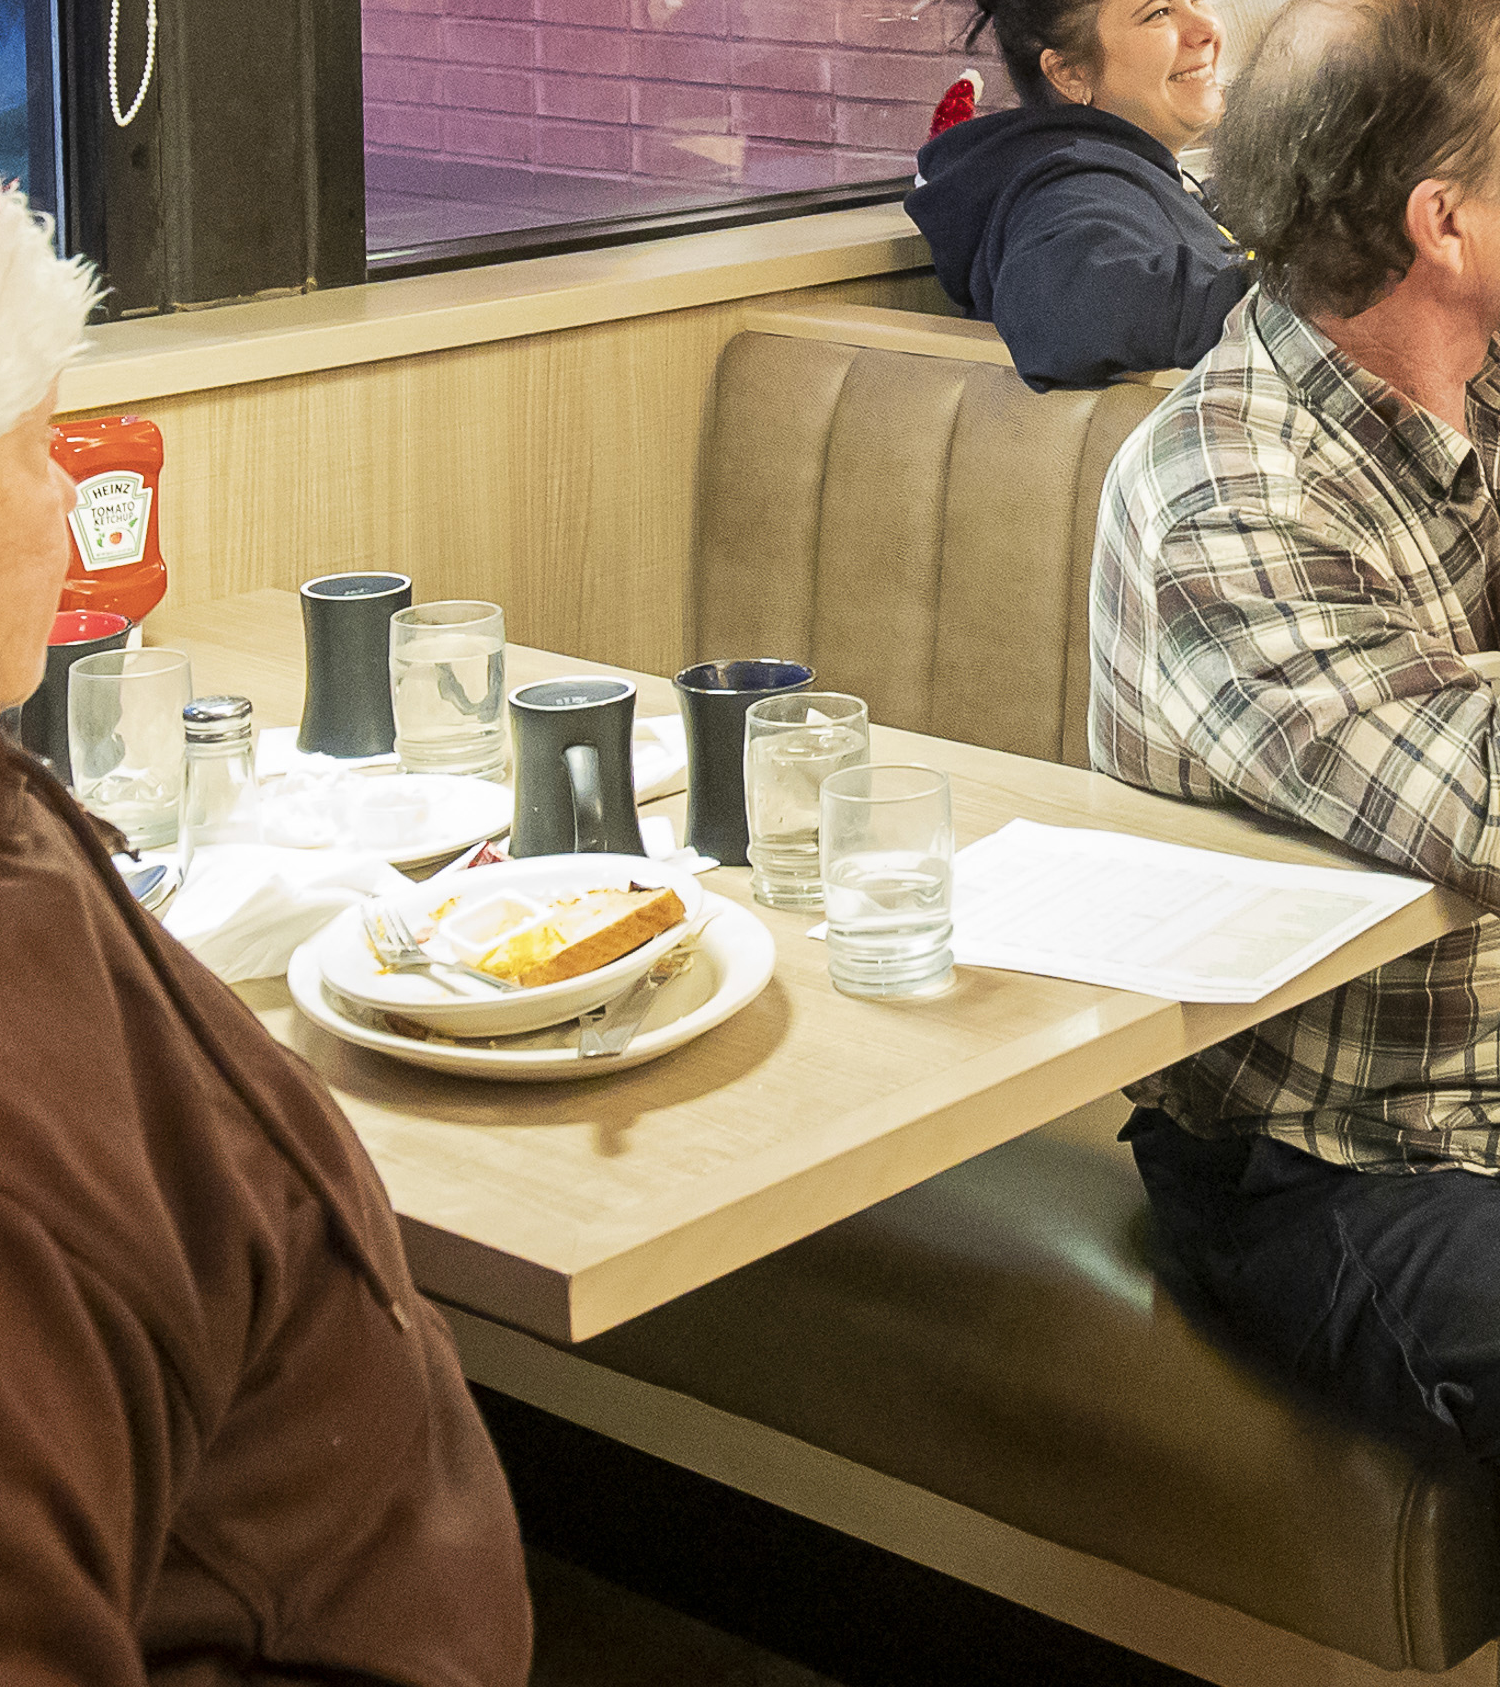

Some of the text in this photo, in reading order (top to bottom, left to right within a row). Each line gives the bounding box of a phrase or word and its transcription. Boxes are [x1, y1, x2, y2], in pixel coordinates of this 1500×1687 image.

[92, 483, 131, 500] HEINZ
[91, 501, 135, 519] TOMATO
[94, 512, 134, 526] KETCHUP
